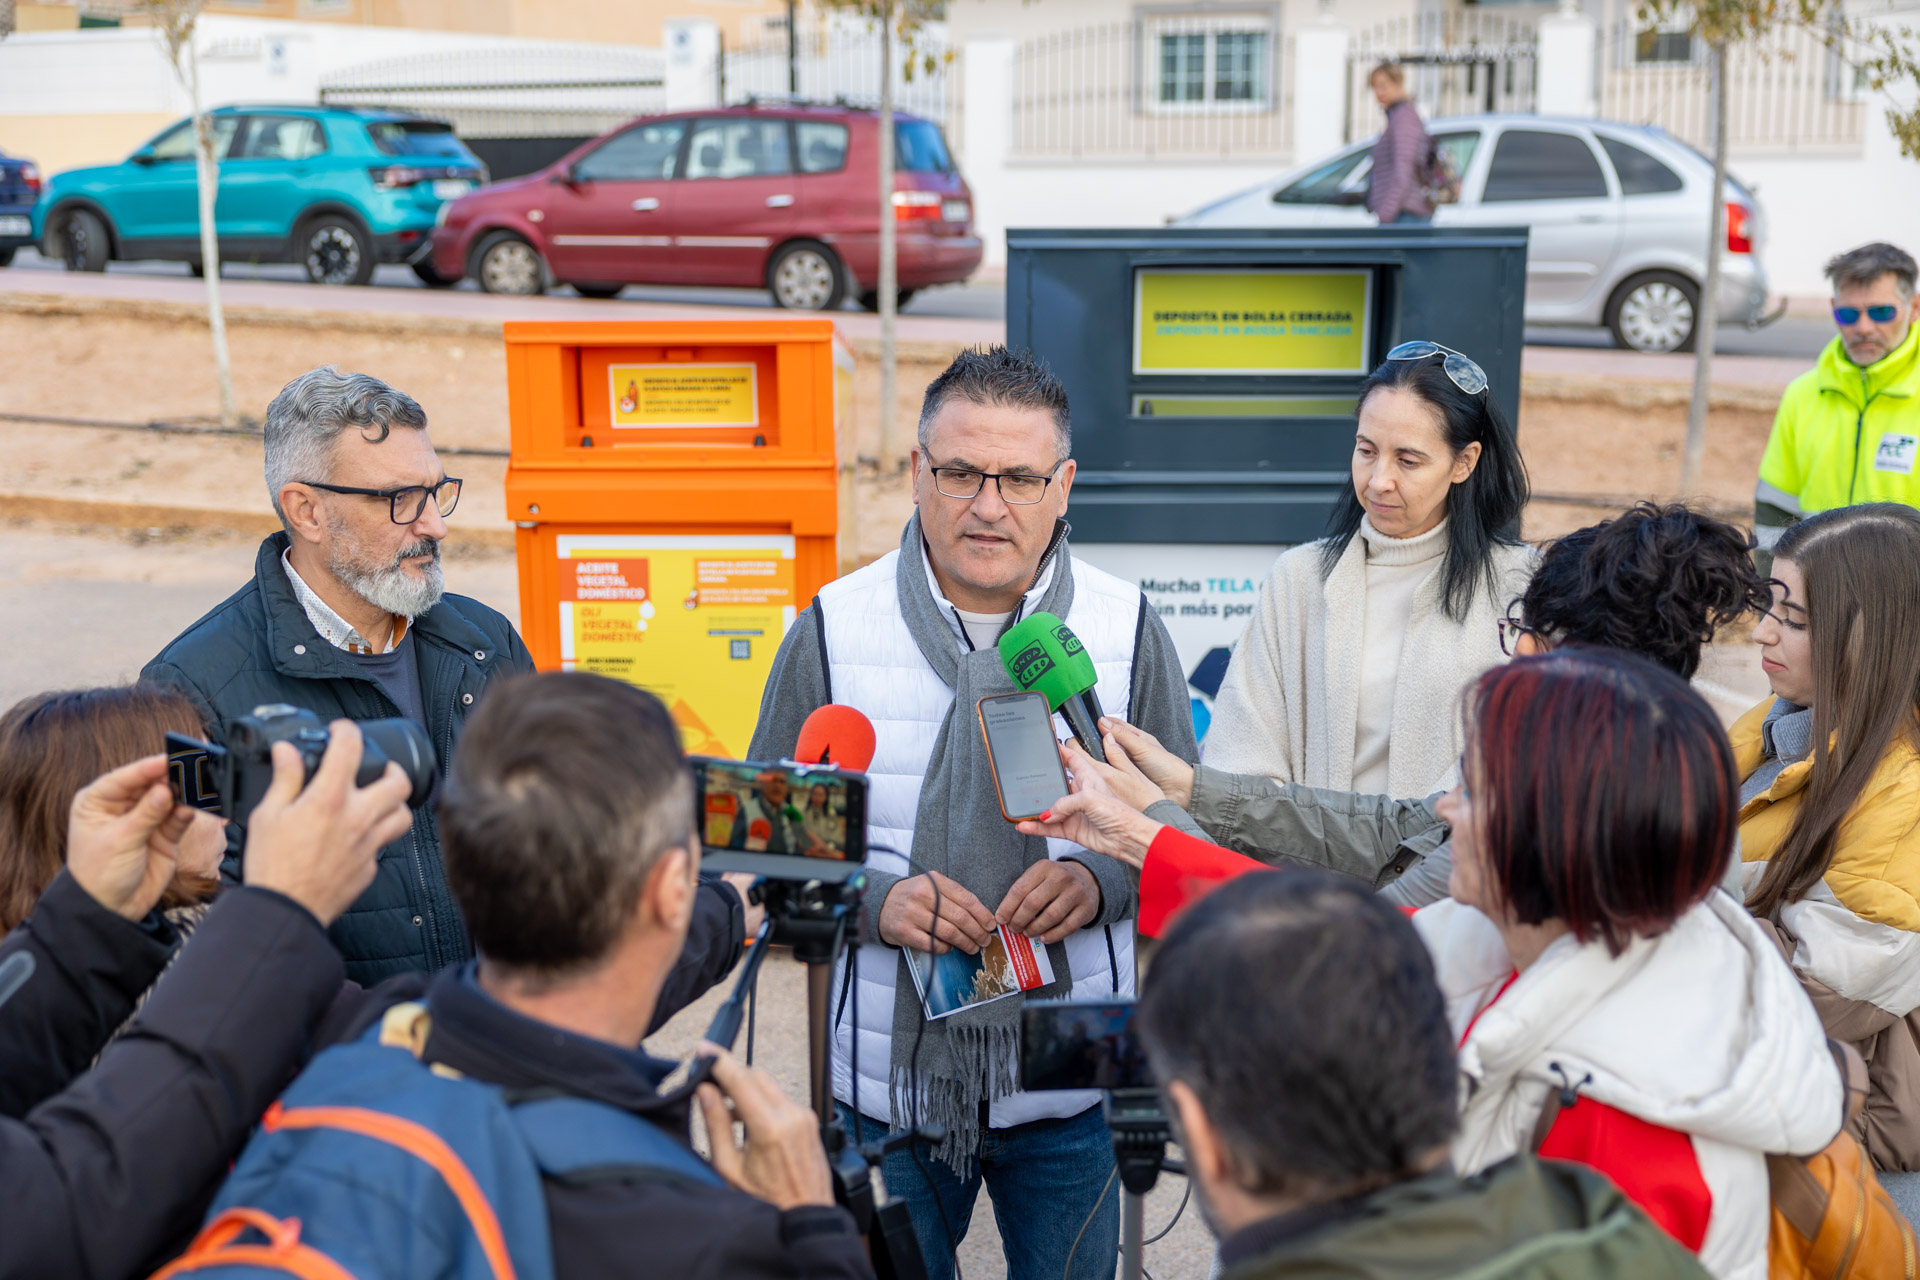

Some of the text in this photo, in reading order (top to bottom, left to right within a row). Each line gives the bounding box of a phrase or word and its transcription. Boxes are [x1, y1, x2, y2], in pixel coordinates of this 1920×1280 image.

[1154, 311, 1353, 323] DEPOSITA EN BOLSA CERRADA
[1222, 324, 1240, 336] EN
[576, 562, 619, 574] ACEITE
[576, 575, 628, 587] VEGETAL
[1140, 579, 1254, 592] Mucha TELA
[577, 587, 646, 600] DOMÉSTICO
[1180, 599, 1218, 616] más
[582, 620, 633, 631] VEGETAL
[1014, 650, 1039, 671] ONDA
[1022, 659, 1046, 681] CERO
